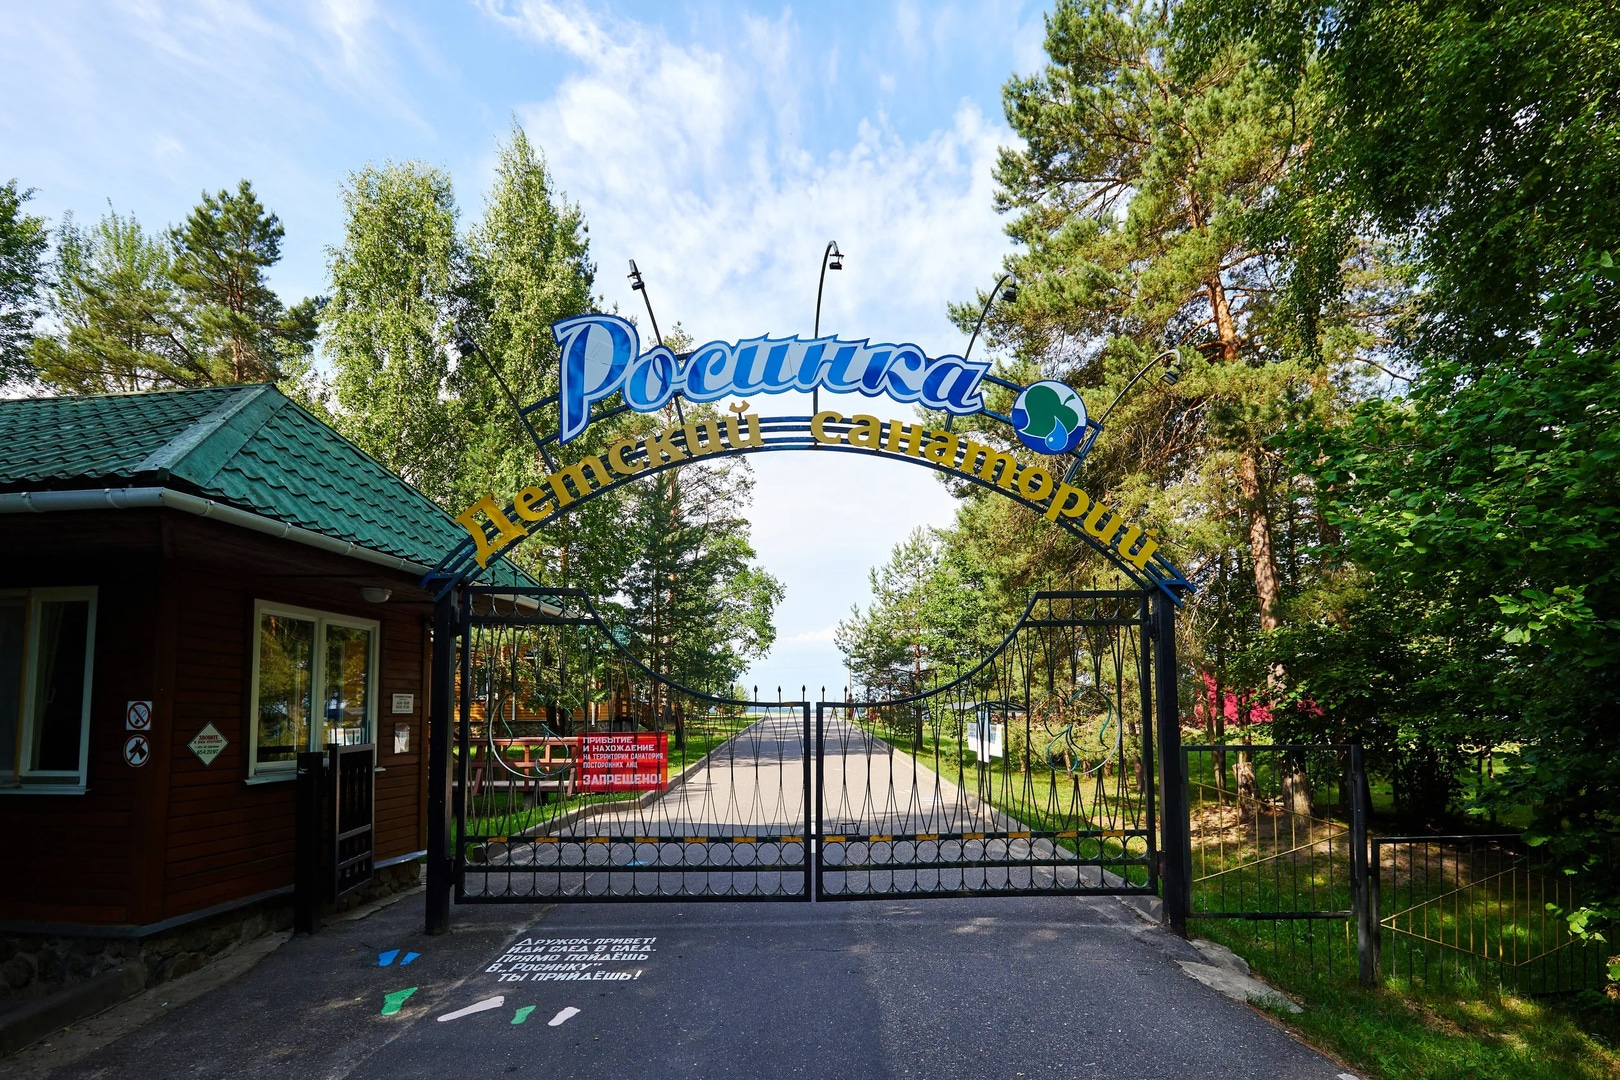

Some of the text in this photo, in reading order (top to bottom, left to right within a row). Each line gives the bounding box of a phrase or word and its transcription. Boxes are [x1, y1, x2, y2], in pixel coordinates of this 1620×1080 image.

[551, 314, 992, 445] Росинка
[455, 400, 1159, 571] Детский санаторий
[582, 736, 633, 744] ПРИБЫТИЕ
[582, 744, 655, 752] И НАХОЖДЕНИЕ
[630, 752, 664, 760] САНАТОРИЯ
[582, 761, 624, 769] ПОСТОРОННИХ
[583, 773, 662, 785] ЗАПРЕЩЕНО!
[506, 945, 544, 954] ИДИ
[547, 945, 590, 953] СЛЕД
[593, 944, 608, 952] В
[496, 952, 649, 963] ПРЯМО ПОЙДЁШЬ
[497, 970, 643, 983] ТЫ ПРИЙДЁШЬ!
